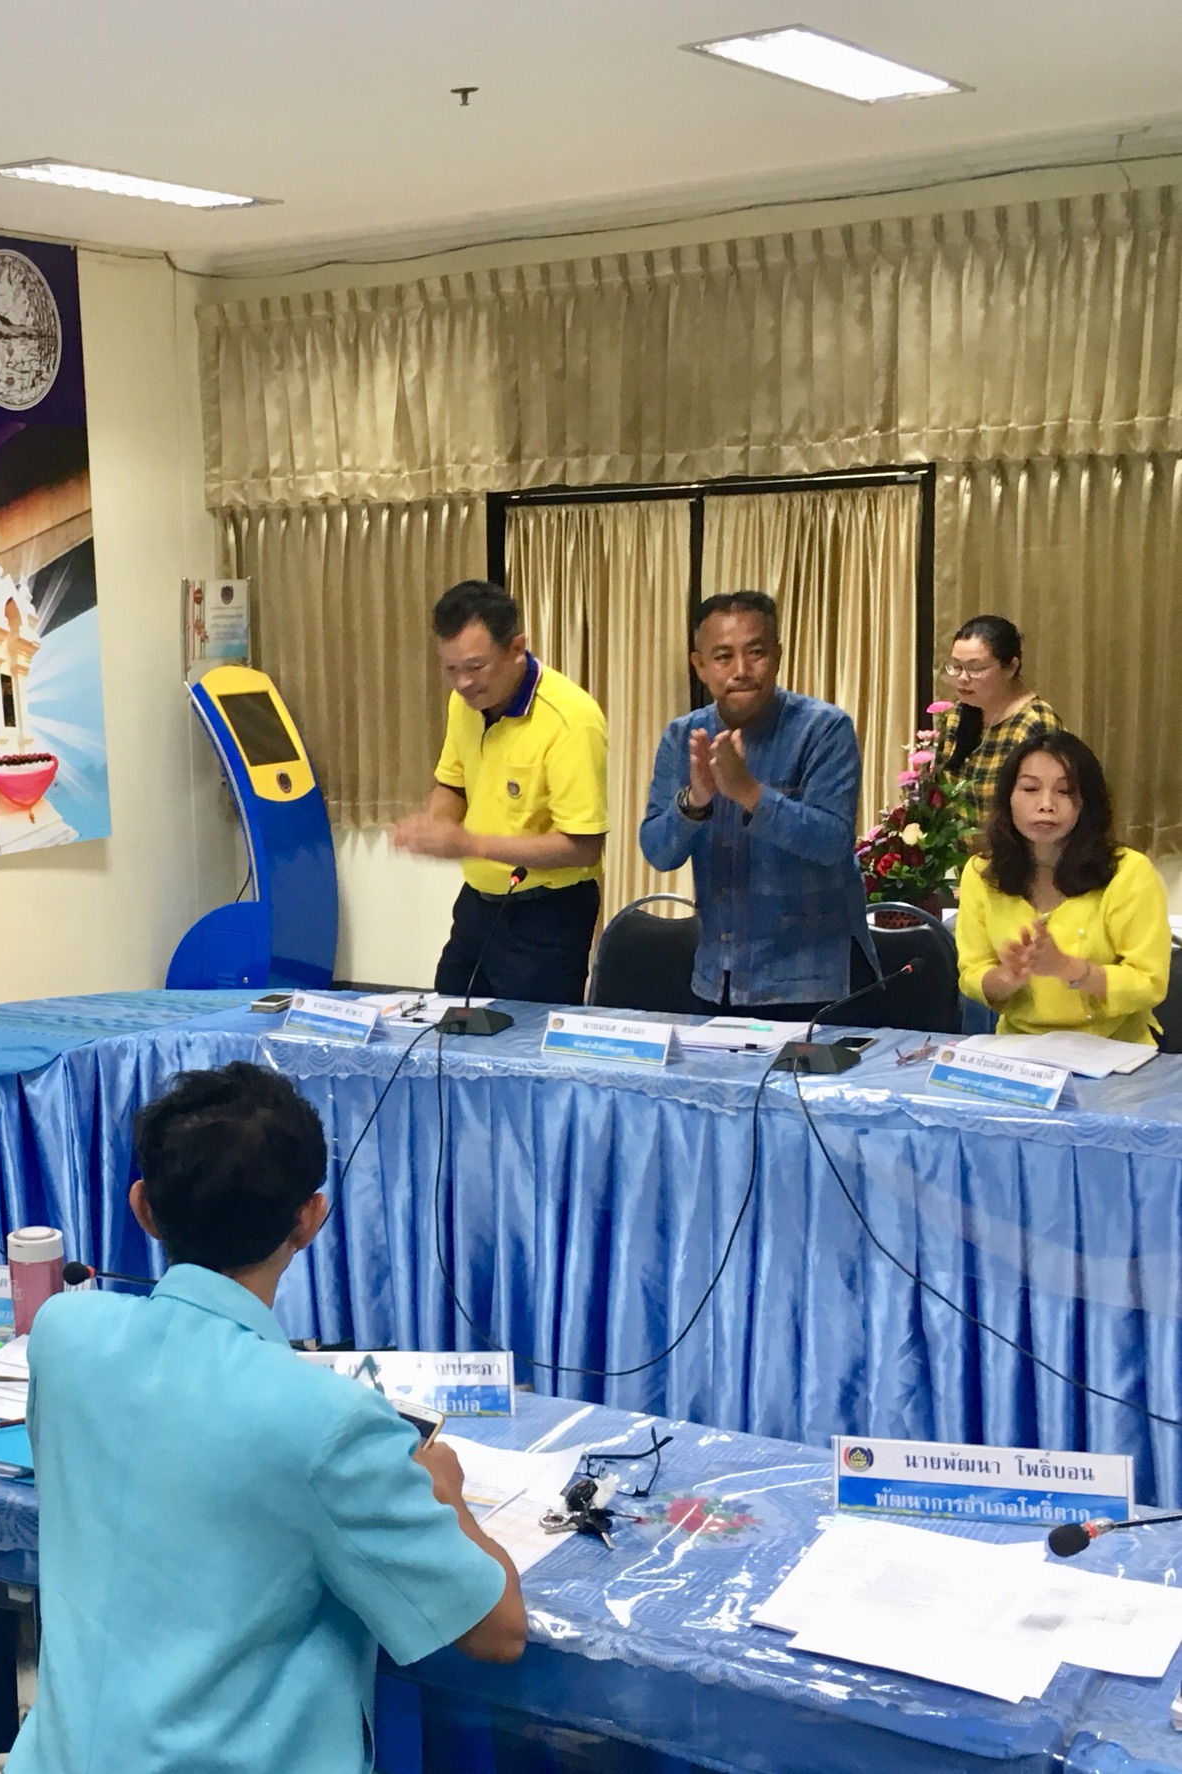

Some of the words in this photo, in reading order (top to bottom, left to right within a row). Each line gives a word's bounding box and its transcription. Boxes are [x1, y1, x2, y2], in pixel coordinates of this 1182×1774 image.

[904, 1451, 1001, 1475] นายพัฒนา
[1015, 1452, 1096, 1482] โพธิ์บอน
